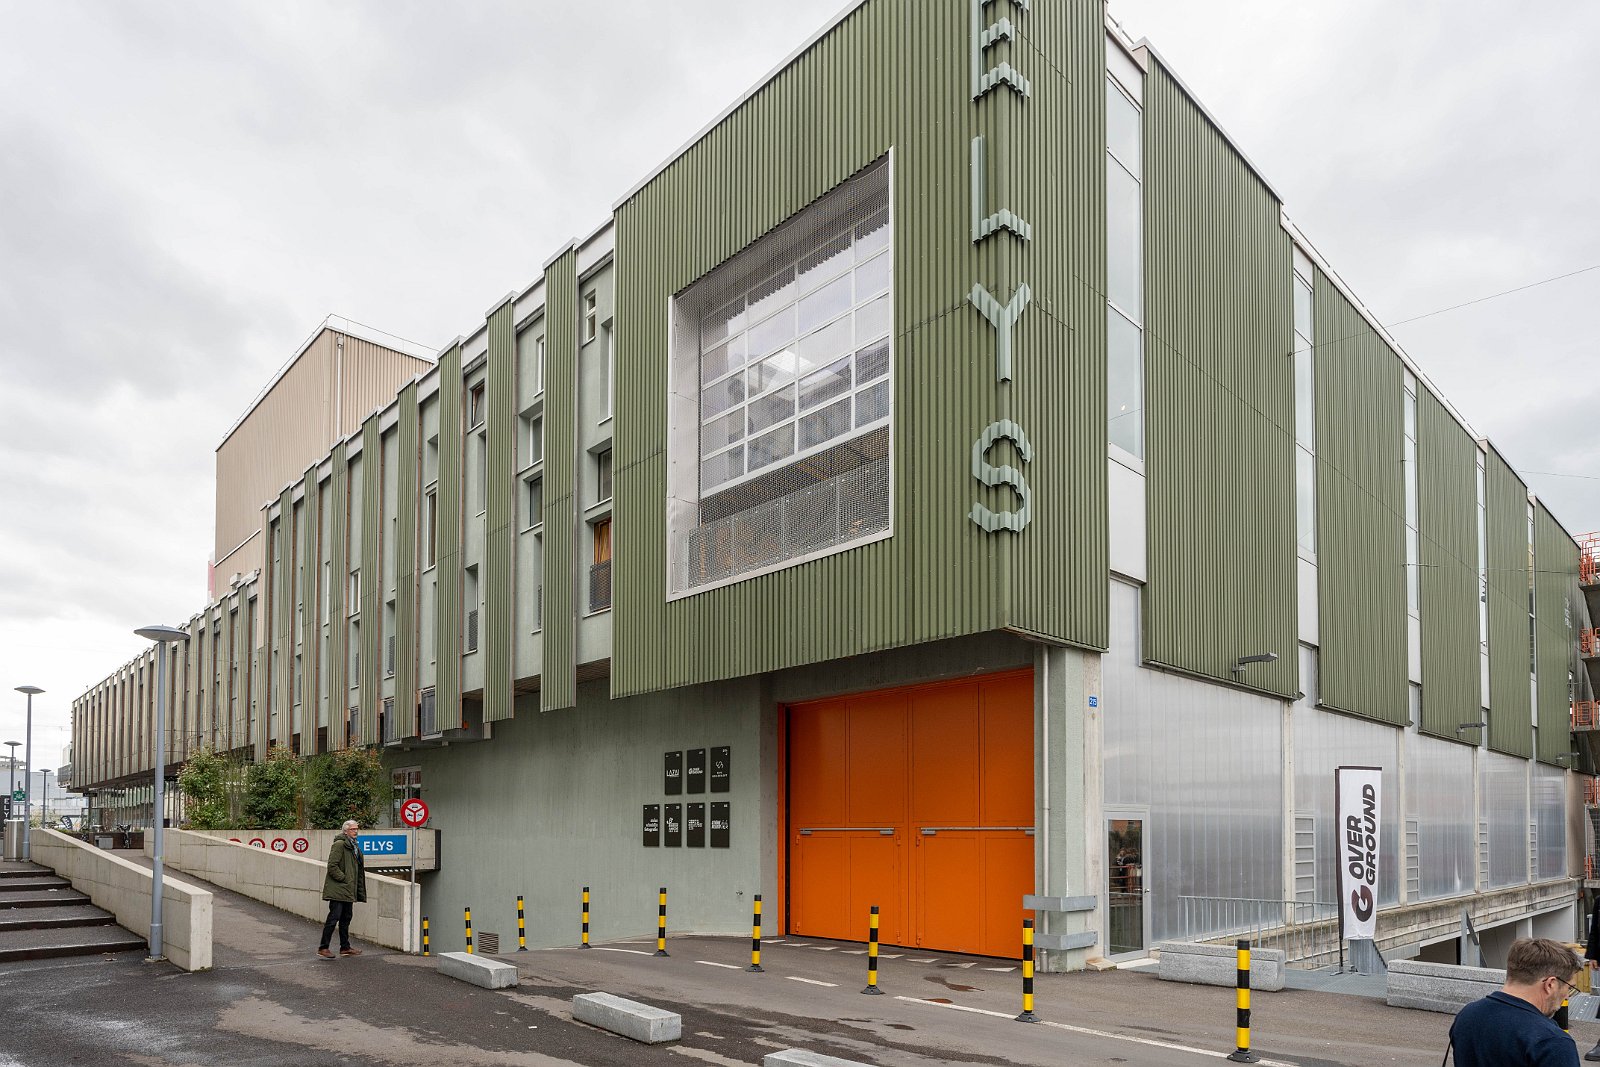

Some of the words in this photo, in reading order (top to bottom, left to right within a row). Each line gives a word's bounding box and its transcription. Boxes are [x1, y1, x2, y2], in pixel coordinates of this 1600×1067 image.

[363, 840, 394, 852] ELYS
[1347, 815, 1364, 880] OVER
[1362, 784, 1375, 884] GROUND
